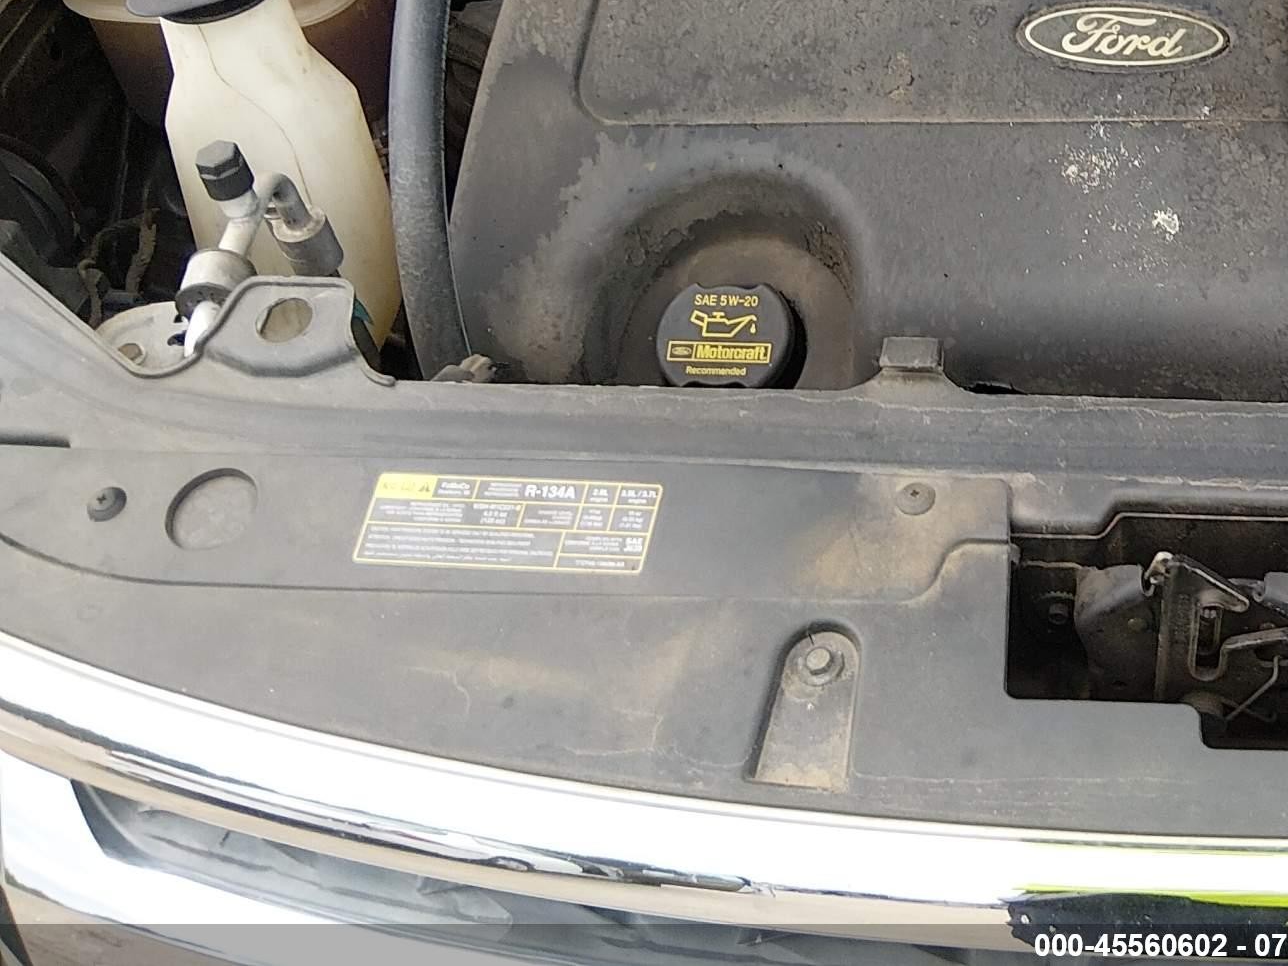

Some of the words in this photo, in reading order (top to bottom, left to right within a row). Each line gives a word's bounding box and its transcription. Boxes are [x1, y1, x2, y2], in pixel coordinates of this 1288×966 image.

[1061, 13, 1187, 58] Ford
[694, 294, 718, 306] SAE
[719, 295, 759, 307] 5W-20
[696, 344, 767, 361] Motorcraft
[685, 365, 747, 376] Recommended
[523, 484, 576, 500] R-134A
